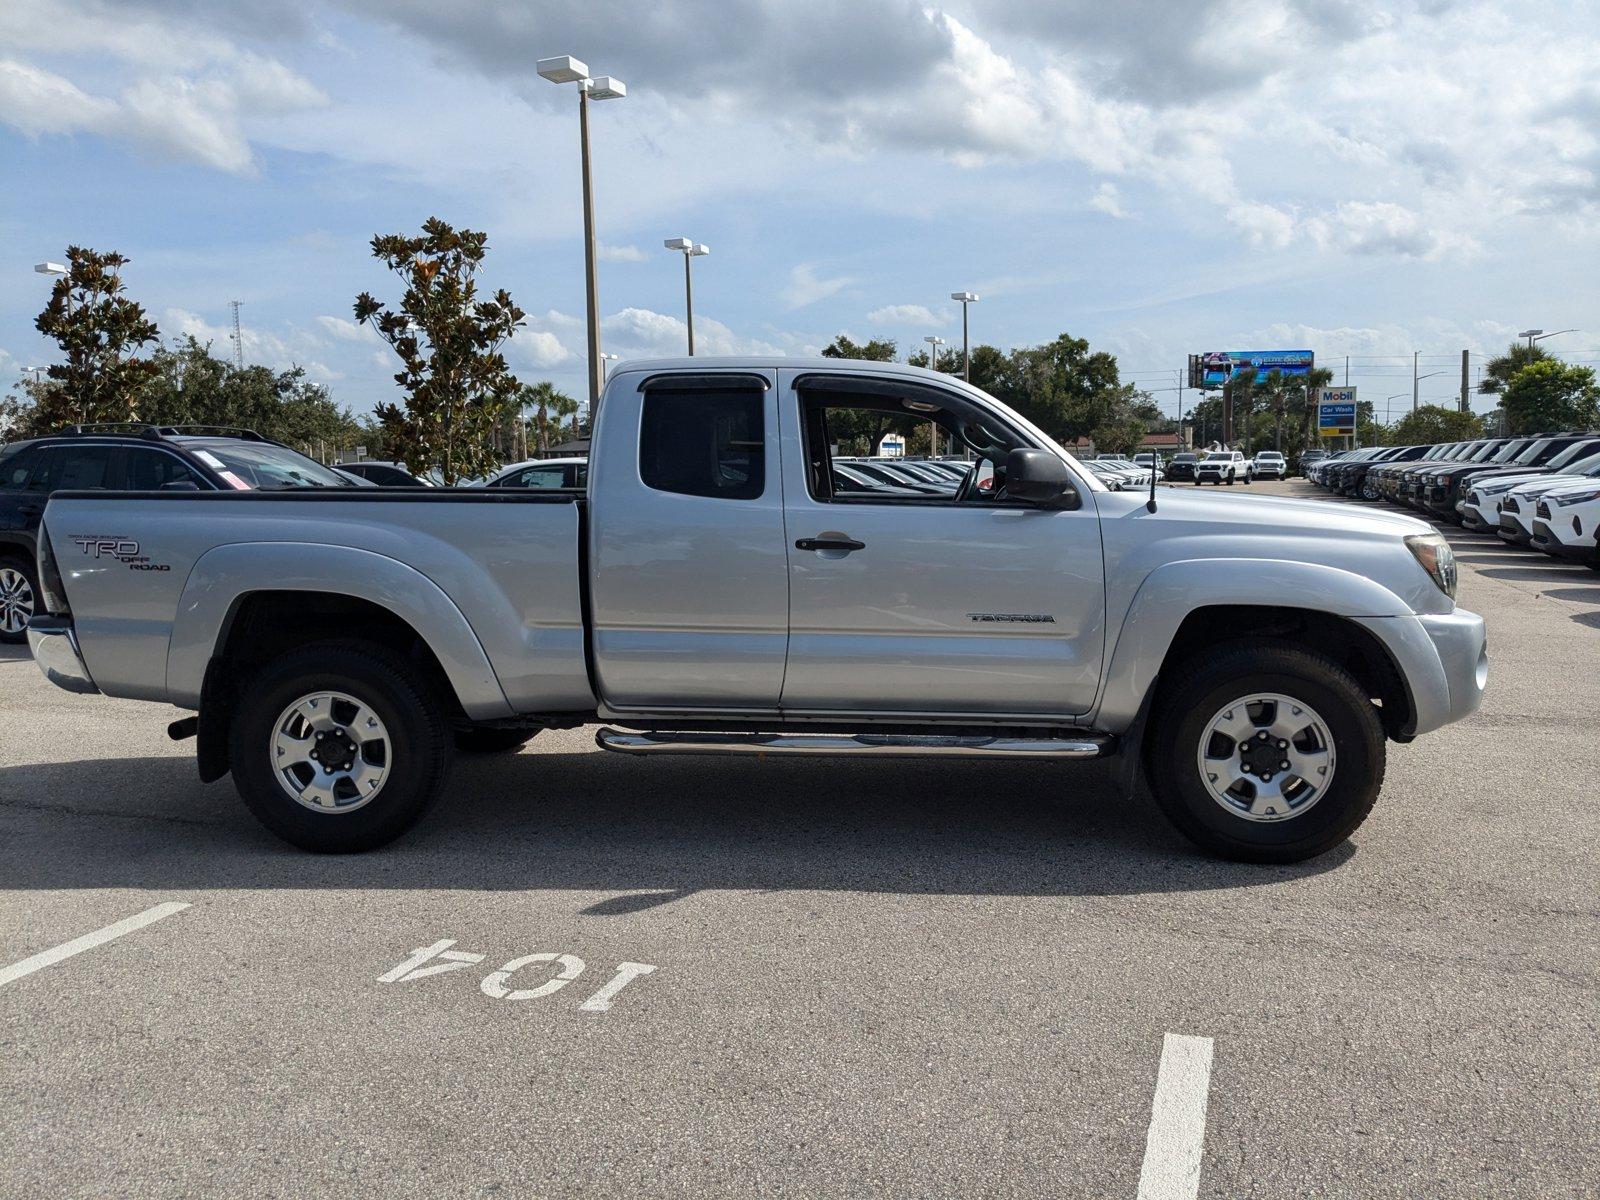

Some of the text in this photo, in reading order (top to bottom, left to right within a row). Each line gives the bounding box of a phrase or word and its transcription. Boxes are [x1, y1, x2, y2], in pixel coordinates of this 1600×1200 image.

[1323, 391, 1353, 401] Mobil
[75, 539, 140, 560] TRD
[376, 938, 658, 1012] 104
